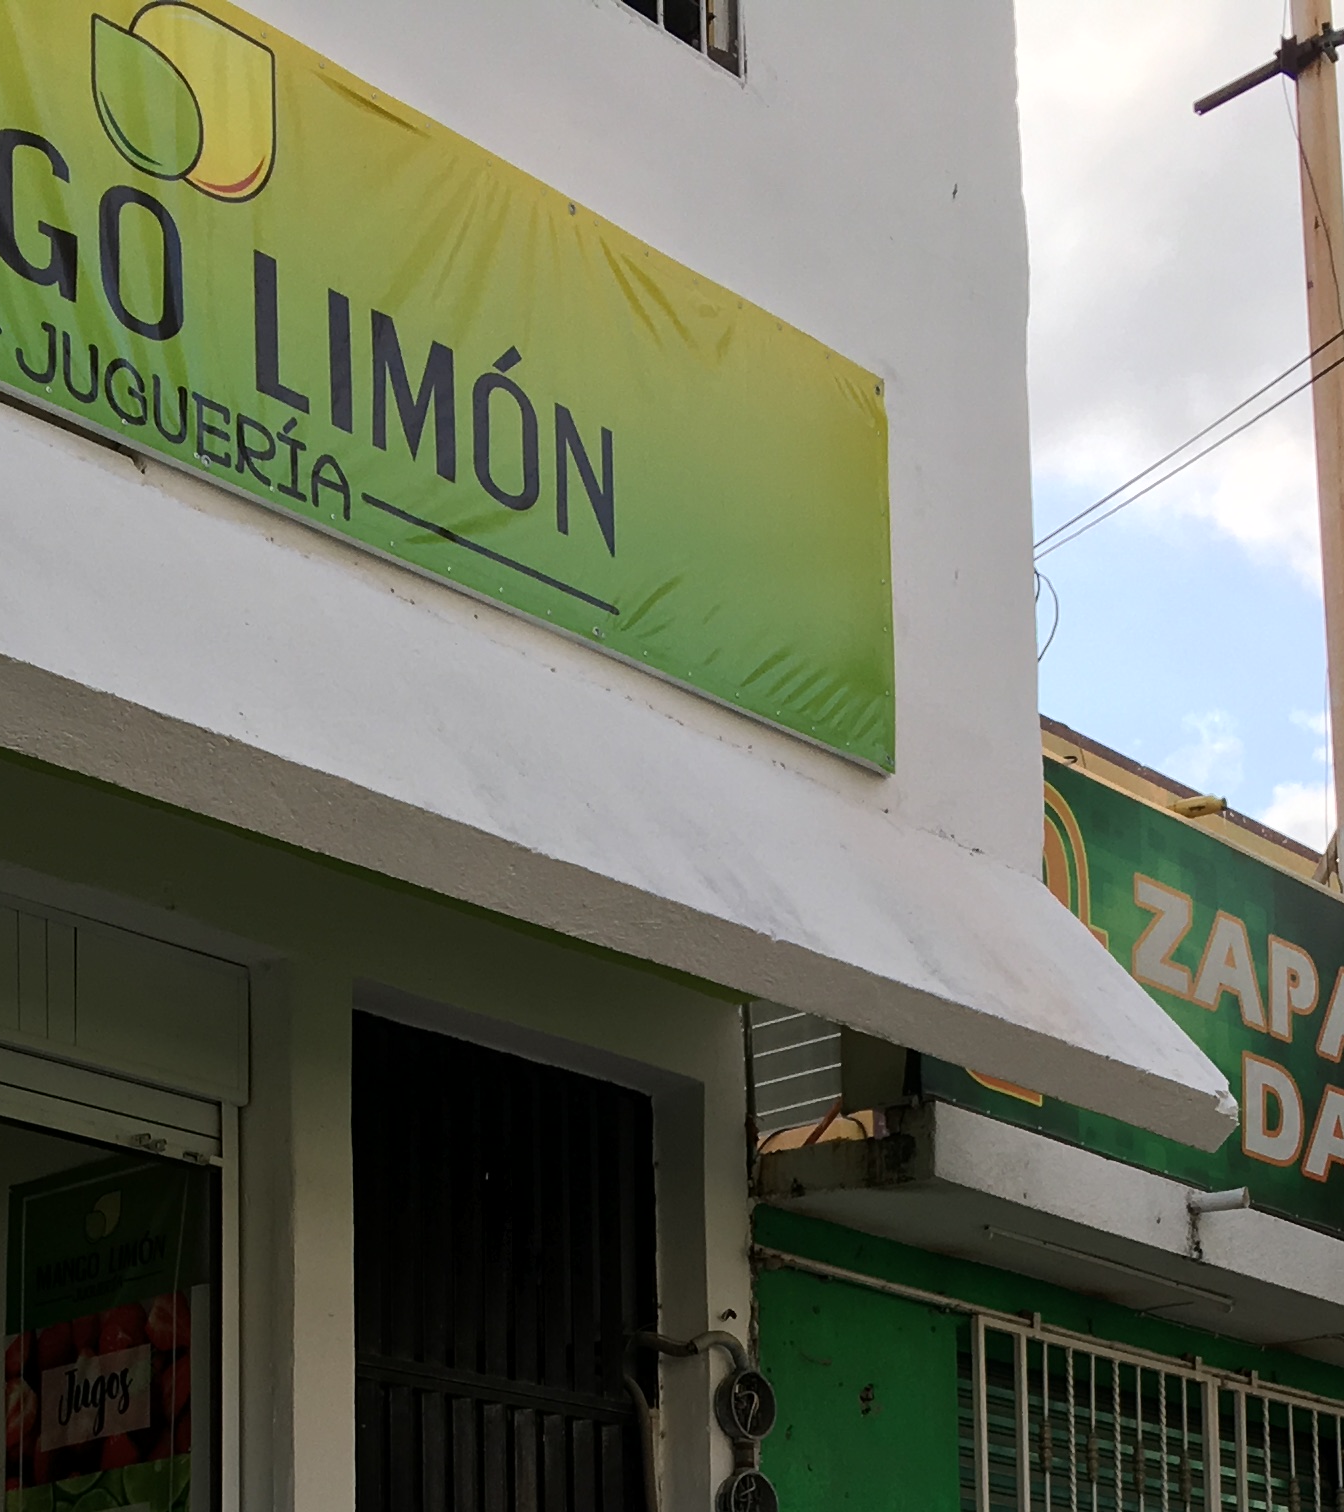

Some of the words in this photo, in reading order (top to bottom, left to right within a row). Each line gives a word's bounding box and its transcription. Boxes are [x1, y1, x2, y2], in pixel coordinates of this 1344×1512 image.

[14, 320, 353, 521] JUGUERÍA
[253, 248, 618, 558] LIMÓN
[36, 1252, 100, 1292] MANGO
[108, 1230, 167, 1273] LIMÓN
[58, 1366, 132, 1433] Jugos
